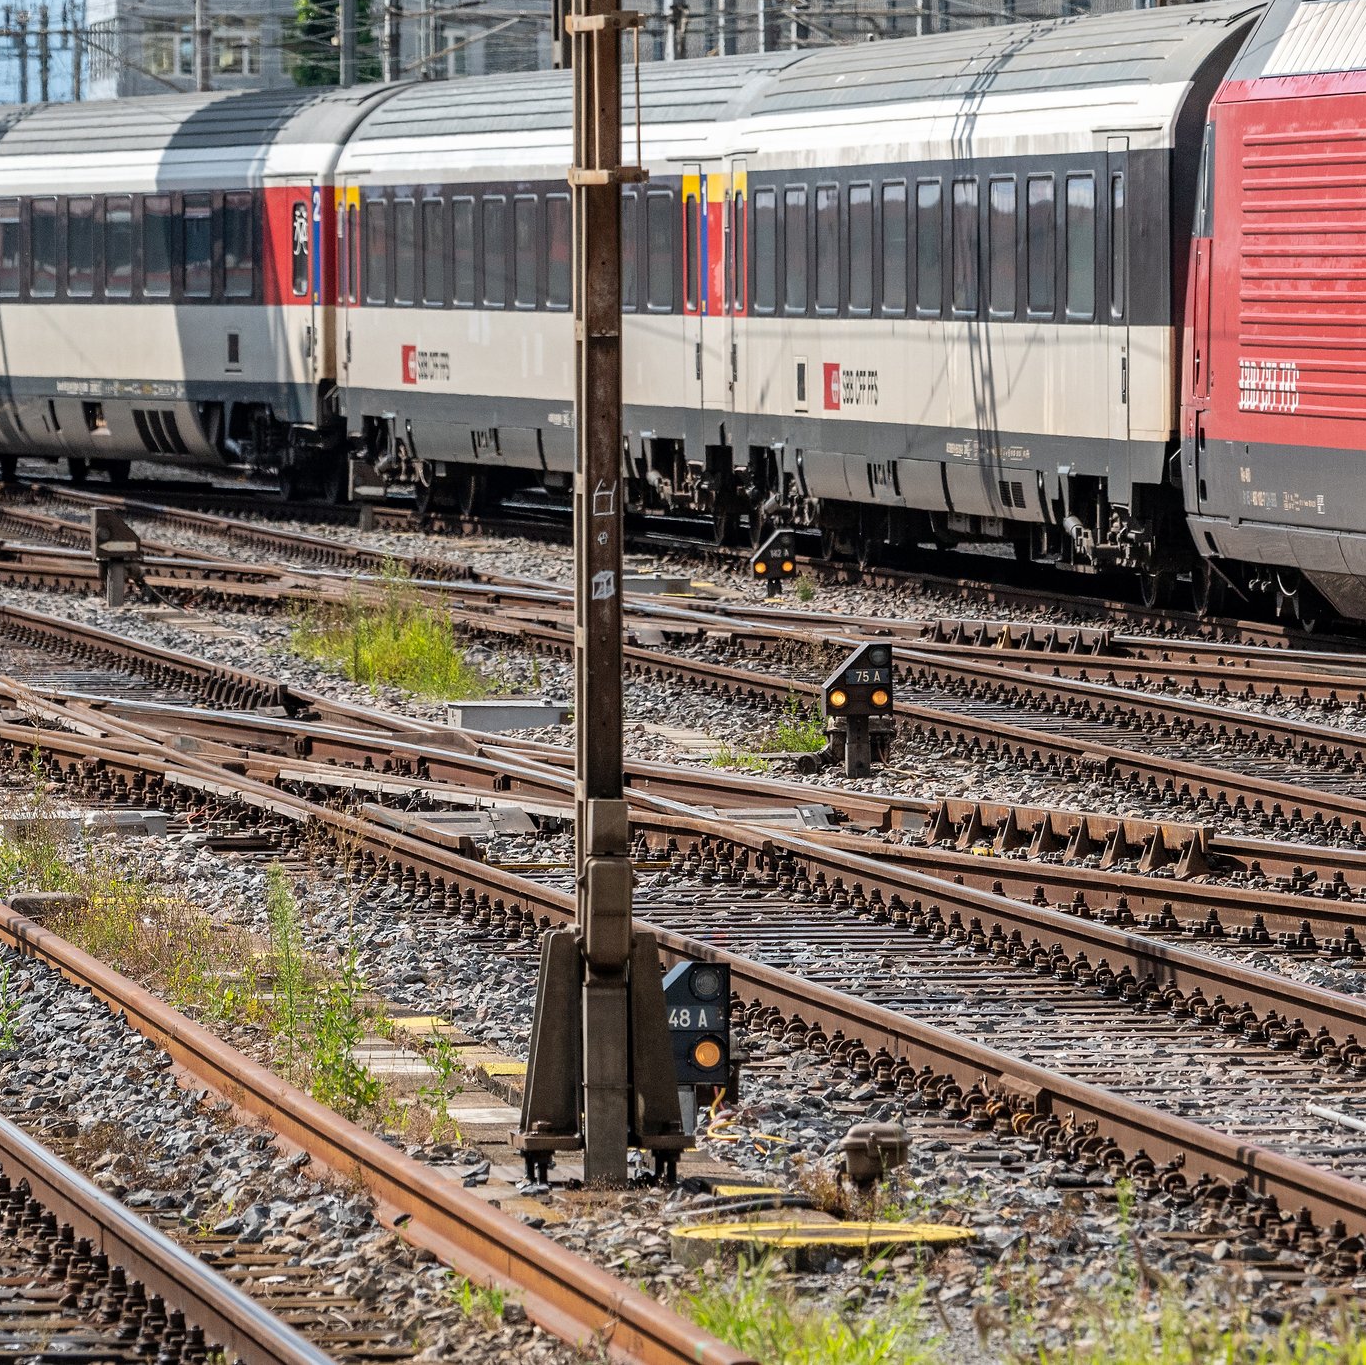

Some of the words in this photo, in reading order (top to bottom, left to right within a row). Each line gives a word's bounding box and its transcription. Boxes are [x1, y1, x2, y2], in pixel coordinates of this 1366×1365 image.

[313, 190, 322, 222] 2
[841, 369, 854, 405] SBB
[855, 369, 866, 406] CFF
[867, 369, 879, 407] FFS
[855, 671, 870, 682] 75
[873, 671, 881, 682] A
[668, 1008, 691, 1028] 48
[698, 1008, 708, 1028] A
